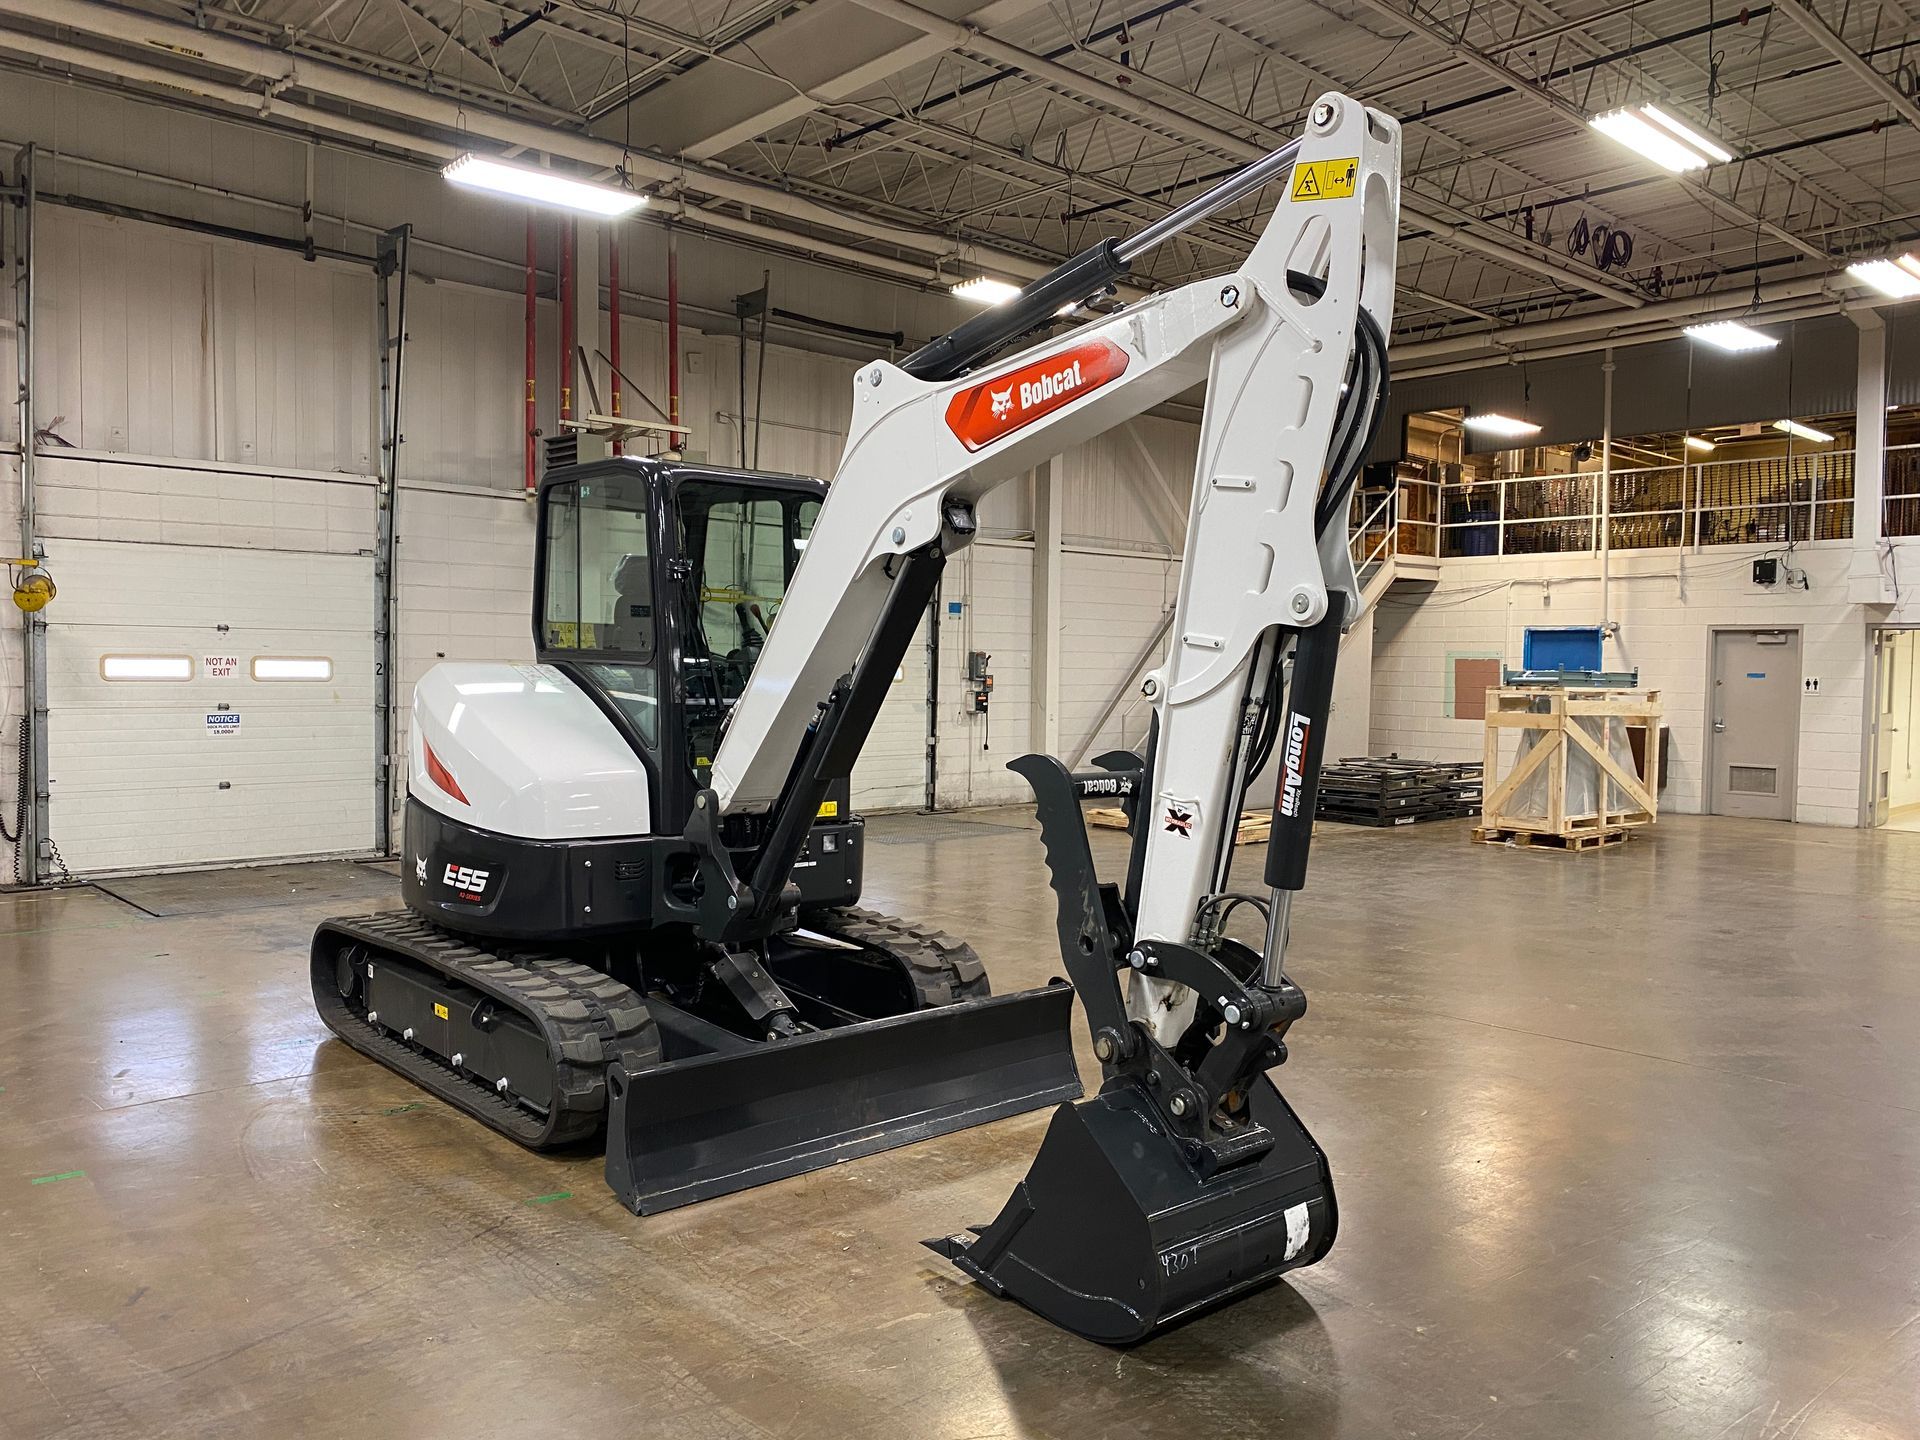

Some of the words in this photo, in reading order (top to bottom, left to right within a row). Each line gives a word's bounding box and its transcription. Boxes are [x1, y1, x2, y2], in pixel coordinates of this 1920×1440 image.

[1020, 360, 1083, 410] Bobcat
[205, 657, 223, 666] NOT
[225, 657, 237, 666] AN
[212, 667, 231, 676] EXIT
[376, 662, 383, 676] 2
[208, 715, 239, 723] NOTICE
[1280, 711, 1311, 817] LongArm
[1083, 778, 1117, 794] Bobcat
